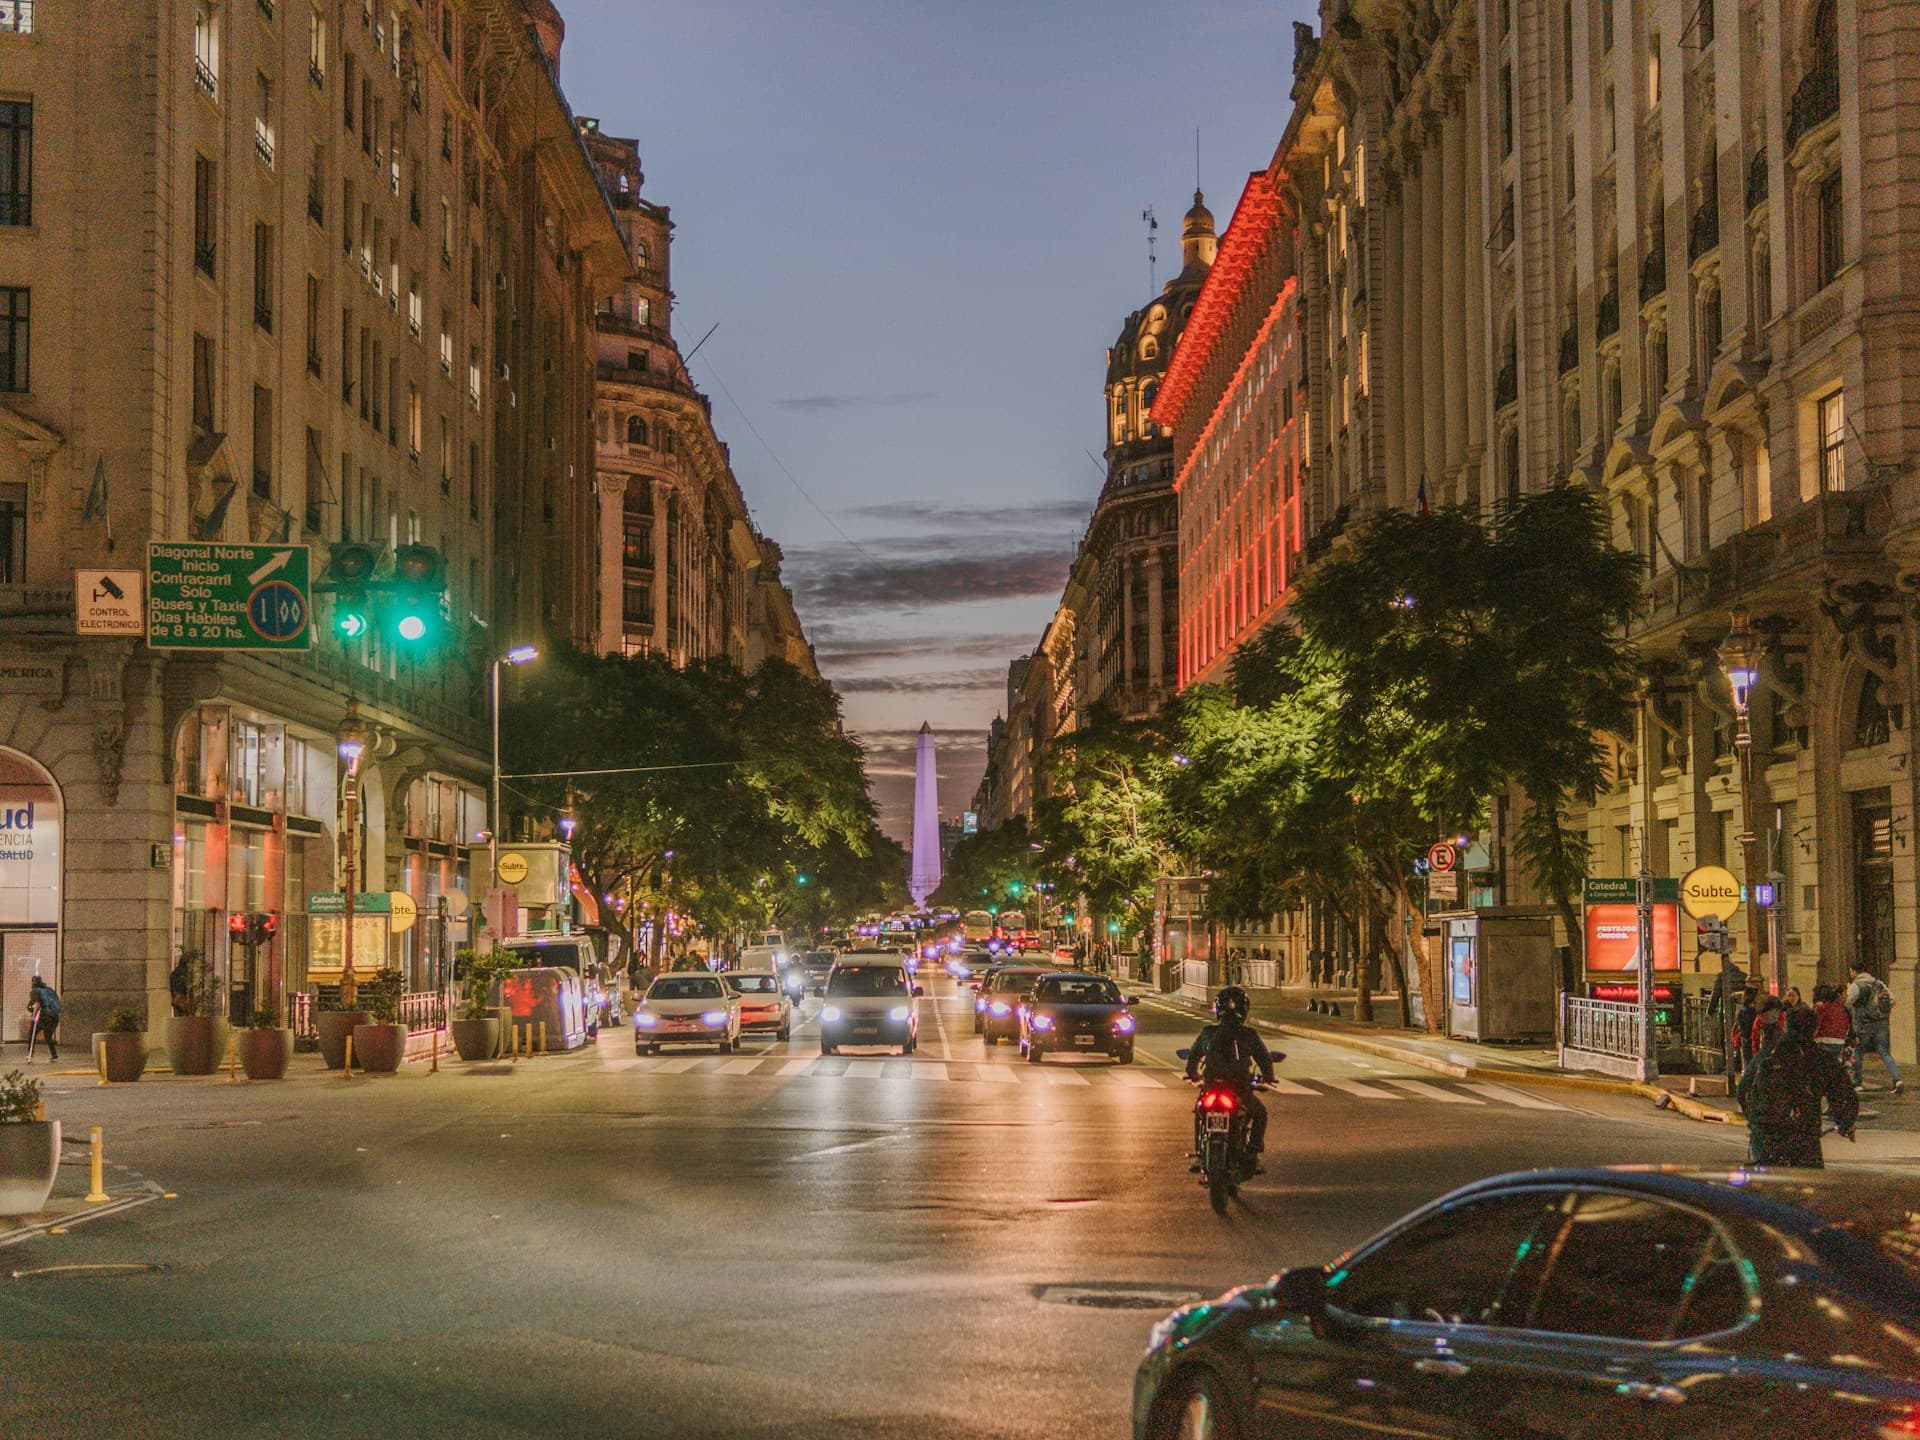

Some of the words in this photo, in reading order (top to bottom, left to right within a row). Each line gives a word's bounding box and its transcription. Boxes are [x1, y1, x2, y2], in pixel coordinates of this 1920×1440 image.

[150, 545, 211, 560] Diagonal
[215, 546, 254, 559] Norte
[182, 559, 220, 572] Inicio
[151, 571, 231, 585] Contracarril
[180, 585, 212, 598] Solo
[89, 608, 130, 616] CONTROL
[151, 598, 194, 610] Buses
[198, 601, 206, 613] y
[212, 599, 247, 613] Taxis
[80, 620, 139, 629] ELECTRONICO
[151, 625, 169, 636] de
[173, 626, 183, 636] 8
[188, 627, 197, 637] a
[202, 626, 221, 638] 20
[225, 626, 246, 639] hs.
[502, 862, 524, 870] Subte
[1588, 881, 1628, 890] Catedral
[1691, 884, 1733, 898] Subte
[311, 895, 345, 904] Catedral
